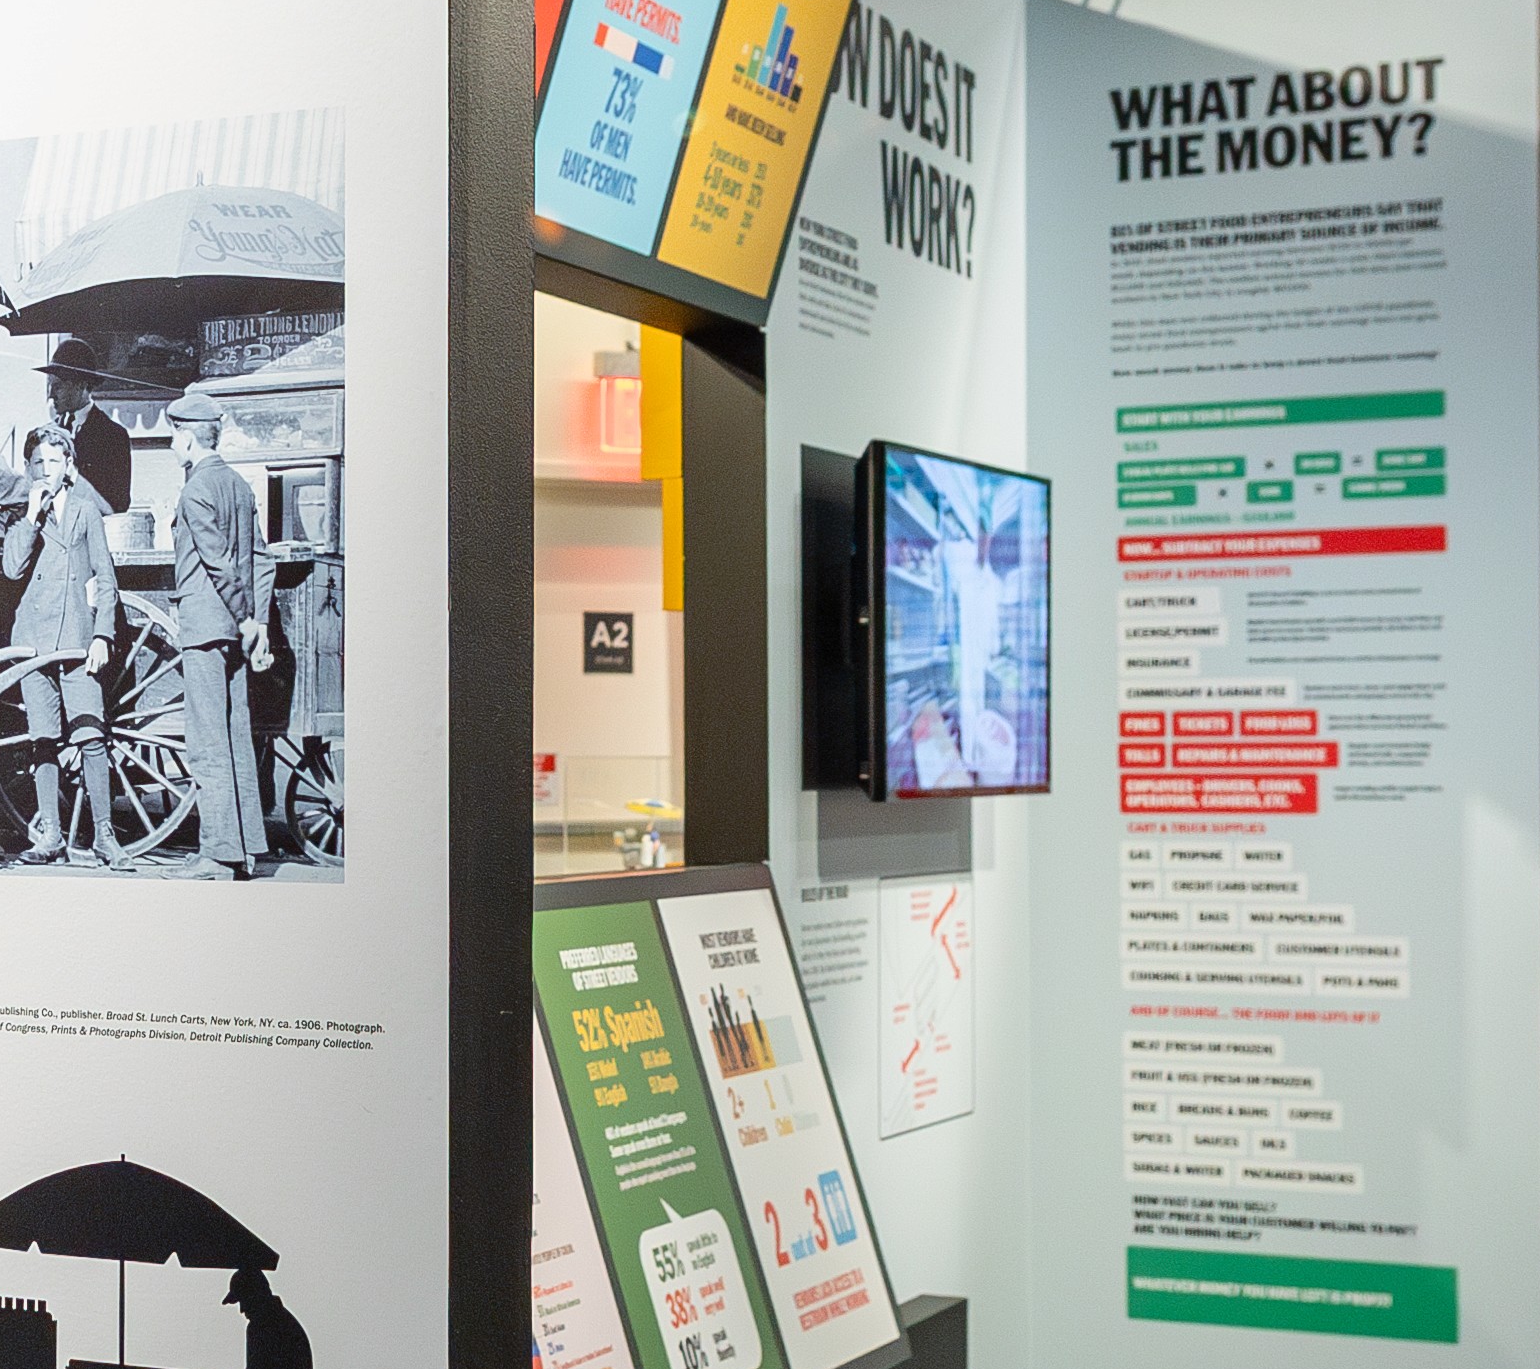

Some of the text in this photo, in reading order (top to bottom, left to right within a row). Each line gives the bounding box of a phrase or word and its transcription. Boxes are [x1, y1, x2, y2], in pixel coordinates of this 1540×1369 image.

[604, 67, 644, 124] 73%
[877, 13, 949, 151] DOES
[954, 60, 976, 164] IT
[1108, 55, 1445, 133] WHAT ABOUT
[603, 125, 633, 163] MEN
[1109, 111, 1436, 184] THE MONEY?
[558, 147, 596, 194] HAVE
[212, 203, 293, 218] WEAR
[880, 138, 976, 280] WORK?
[228, 318, 257, 342] REAL
[258, 316, 293, 338] THING
[590, 621, 629, 648] A2
[4, 1021, 49, 1035] Congress,
[50, 1024, 78, 1036] Prints
[88, 1026, 147, 1040] Photographs
[189, 1030, 223, 1043] Detroit
[223, 1032, 274, 1048] Publishing
[274, 1034, 321, 1050] Company
[322, 1037, 374, 1051] Collection.
[105, 1010, 135, 1022] Broad
[149, 1012, 179, 1024] Lunch
[209, 1015, 232, 1027] New
[294, 1019, 324, 1031] 1906.
[326, 1020, 386, 1036] Photograph.
[572, 998, 665, 1053] 52% Spanish
[652, 1240, 685, 1283] 55%
[665, 1285, 699, 1330] 38%
